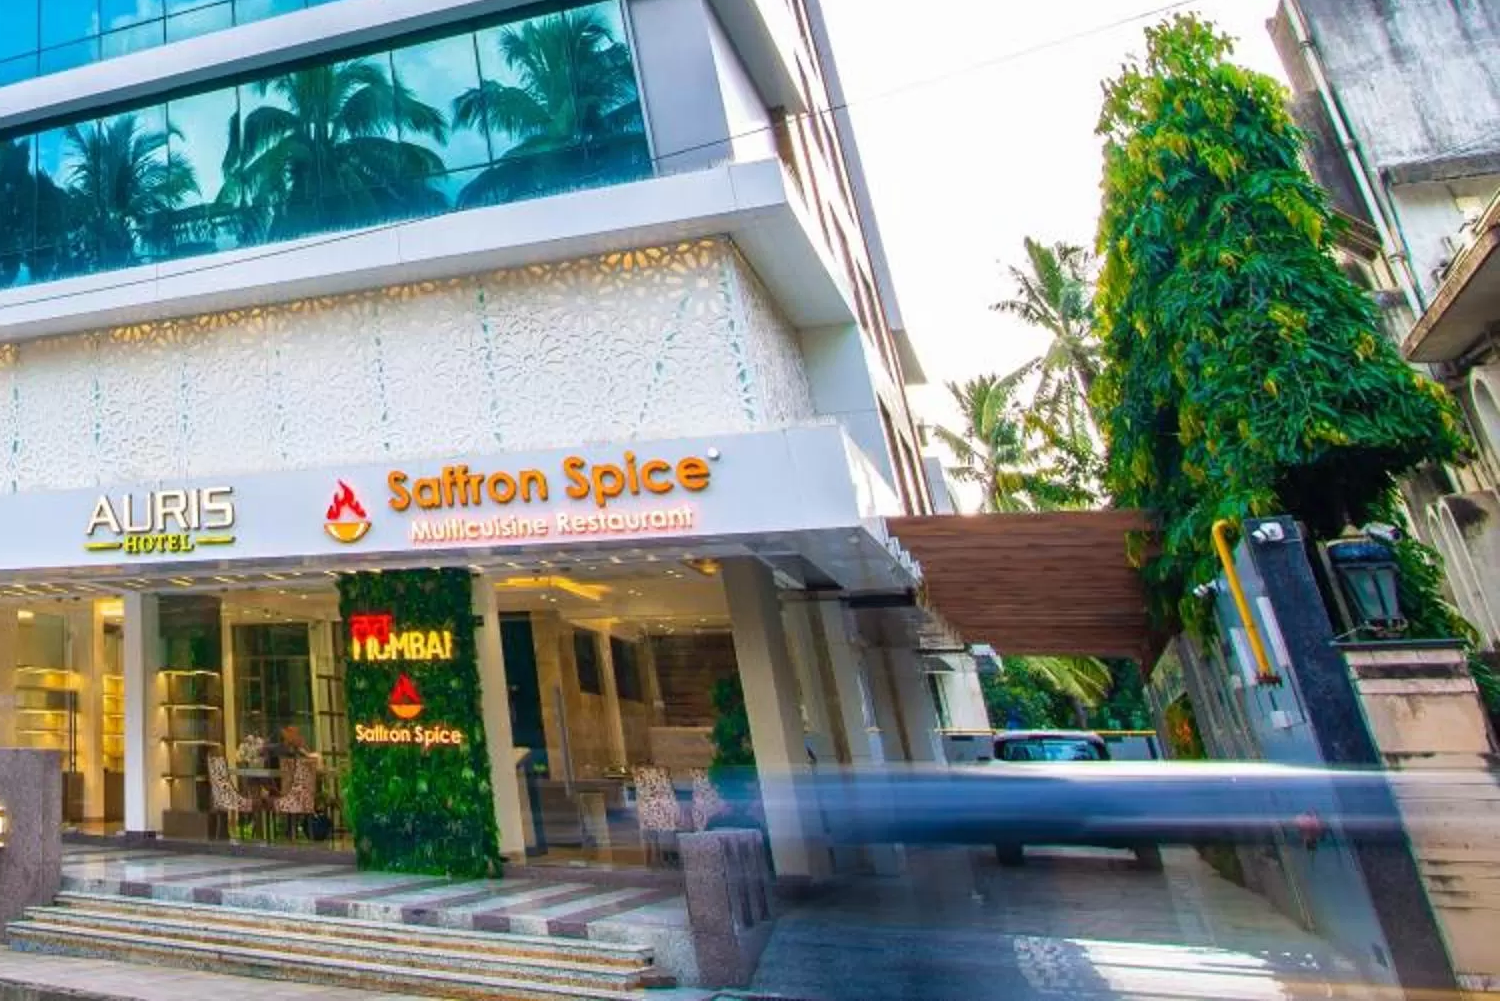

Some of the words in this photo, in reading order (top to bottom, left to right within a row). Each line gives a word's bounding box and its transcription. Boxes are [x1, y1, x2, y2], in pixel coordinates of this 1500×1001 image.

[387, 463, 549, 511] Saffron
[562, 450, 711, 507] Spice
[85, 486, 235, 535] AURIS
[410, 514, 548, 544] Multicuisine
[555, 505, 694, 536] Restaurant
[123, 533, 195, 554] HOTEL
[355, 724, 411, 742] Saffron
[414, 725, 463, 747] Spice
